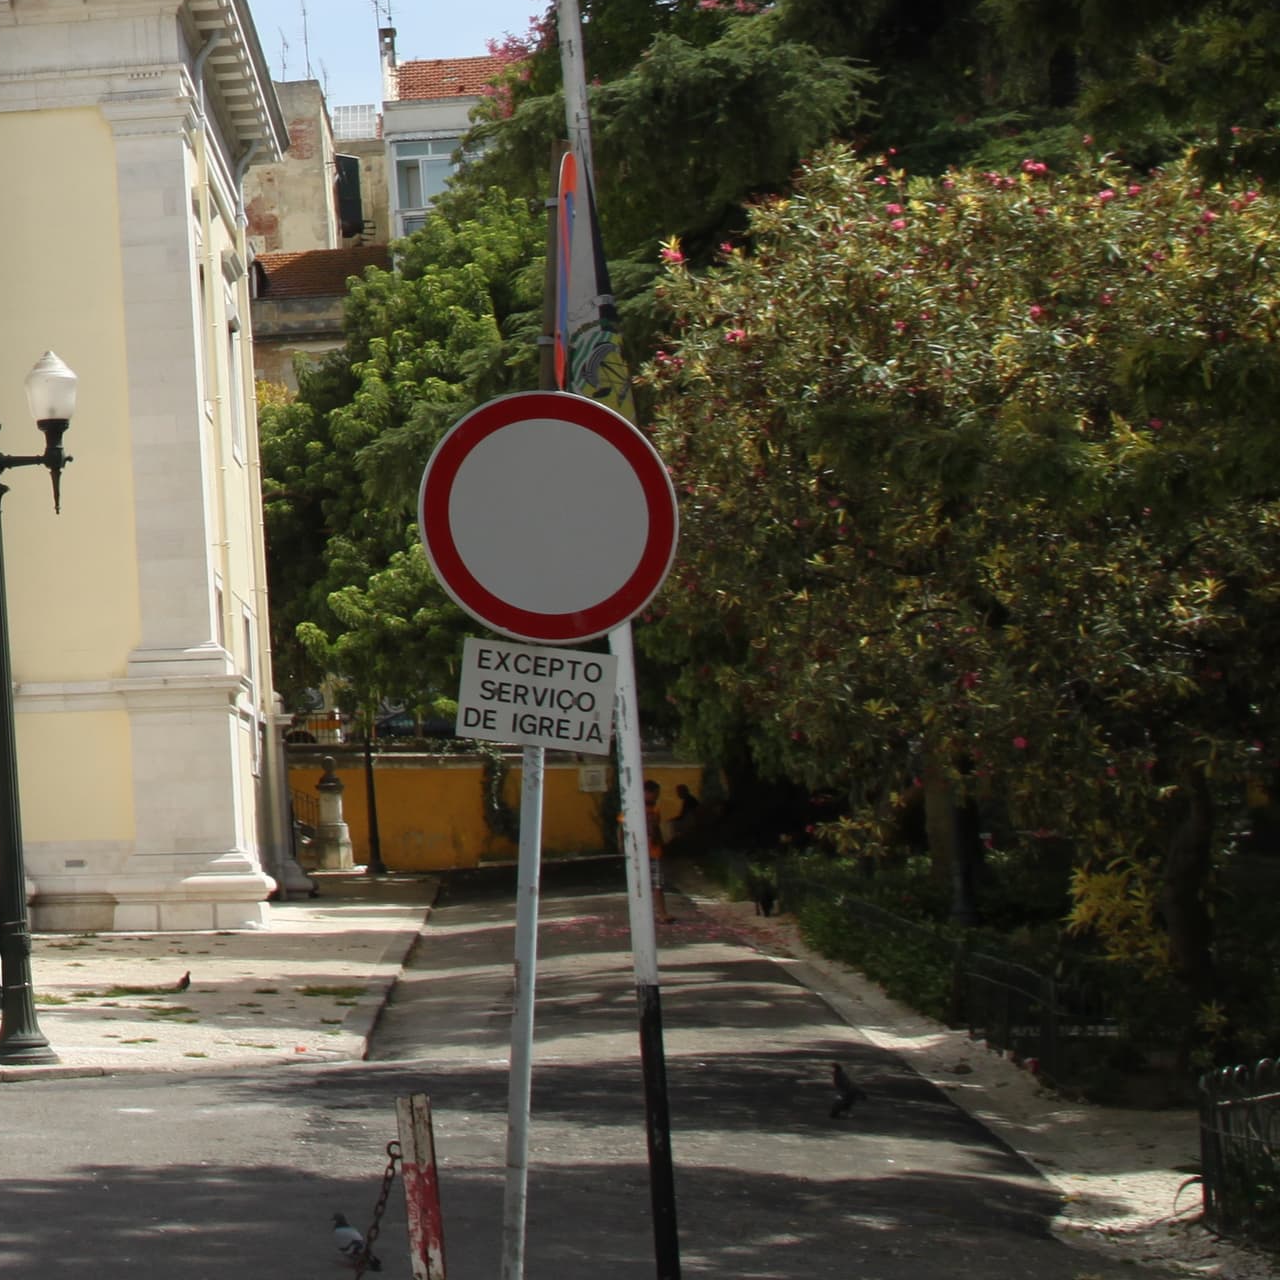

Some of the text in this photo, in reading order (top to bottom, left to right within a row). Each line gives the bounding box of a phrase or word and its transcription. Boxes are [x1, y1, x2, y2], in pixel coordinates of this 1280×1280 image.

[477, 649, 602, 683] EXCEPTO
[480, 680, 595, 713] SERVIÇO
[464, 708, 603, 744] DE IGREJA
